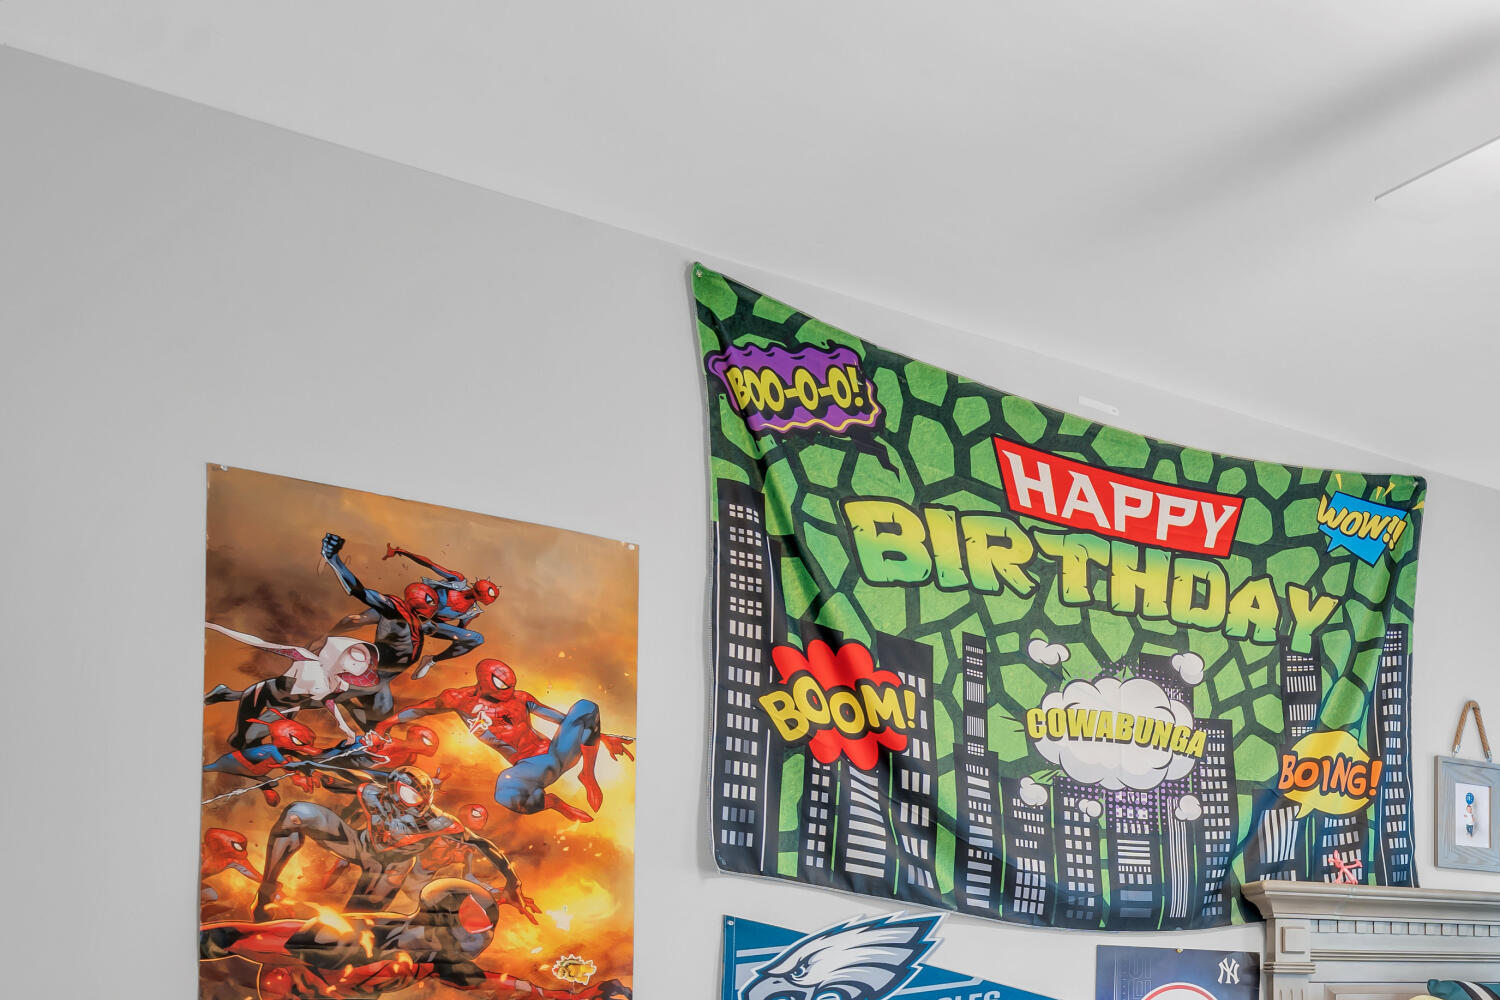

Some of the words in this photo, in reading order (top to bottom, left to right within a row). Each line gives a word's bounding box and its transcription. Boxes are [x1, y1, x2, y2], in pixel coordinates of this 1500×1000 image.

[726, 364, 865, 413] BOO-O-O!
[1001, 447, 1239, 550] HAPPY
[1317, 494, 1408, 551] WOW!!
[842, 499, 1341, 654] BIRTHDAY
[758, 678, 918, 743] BOOM!
[1026, 705, 1208, 761] COWABUNGA
[1278, 749, 1383, 799] BOING!
